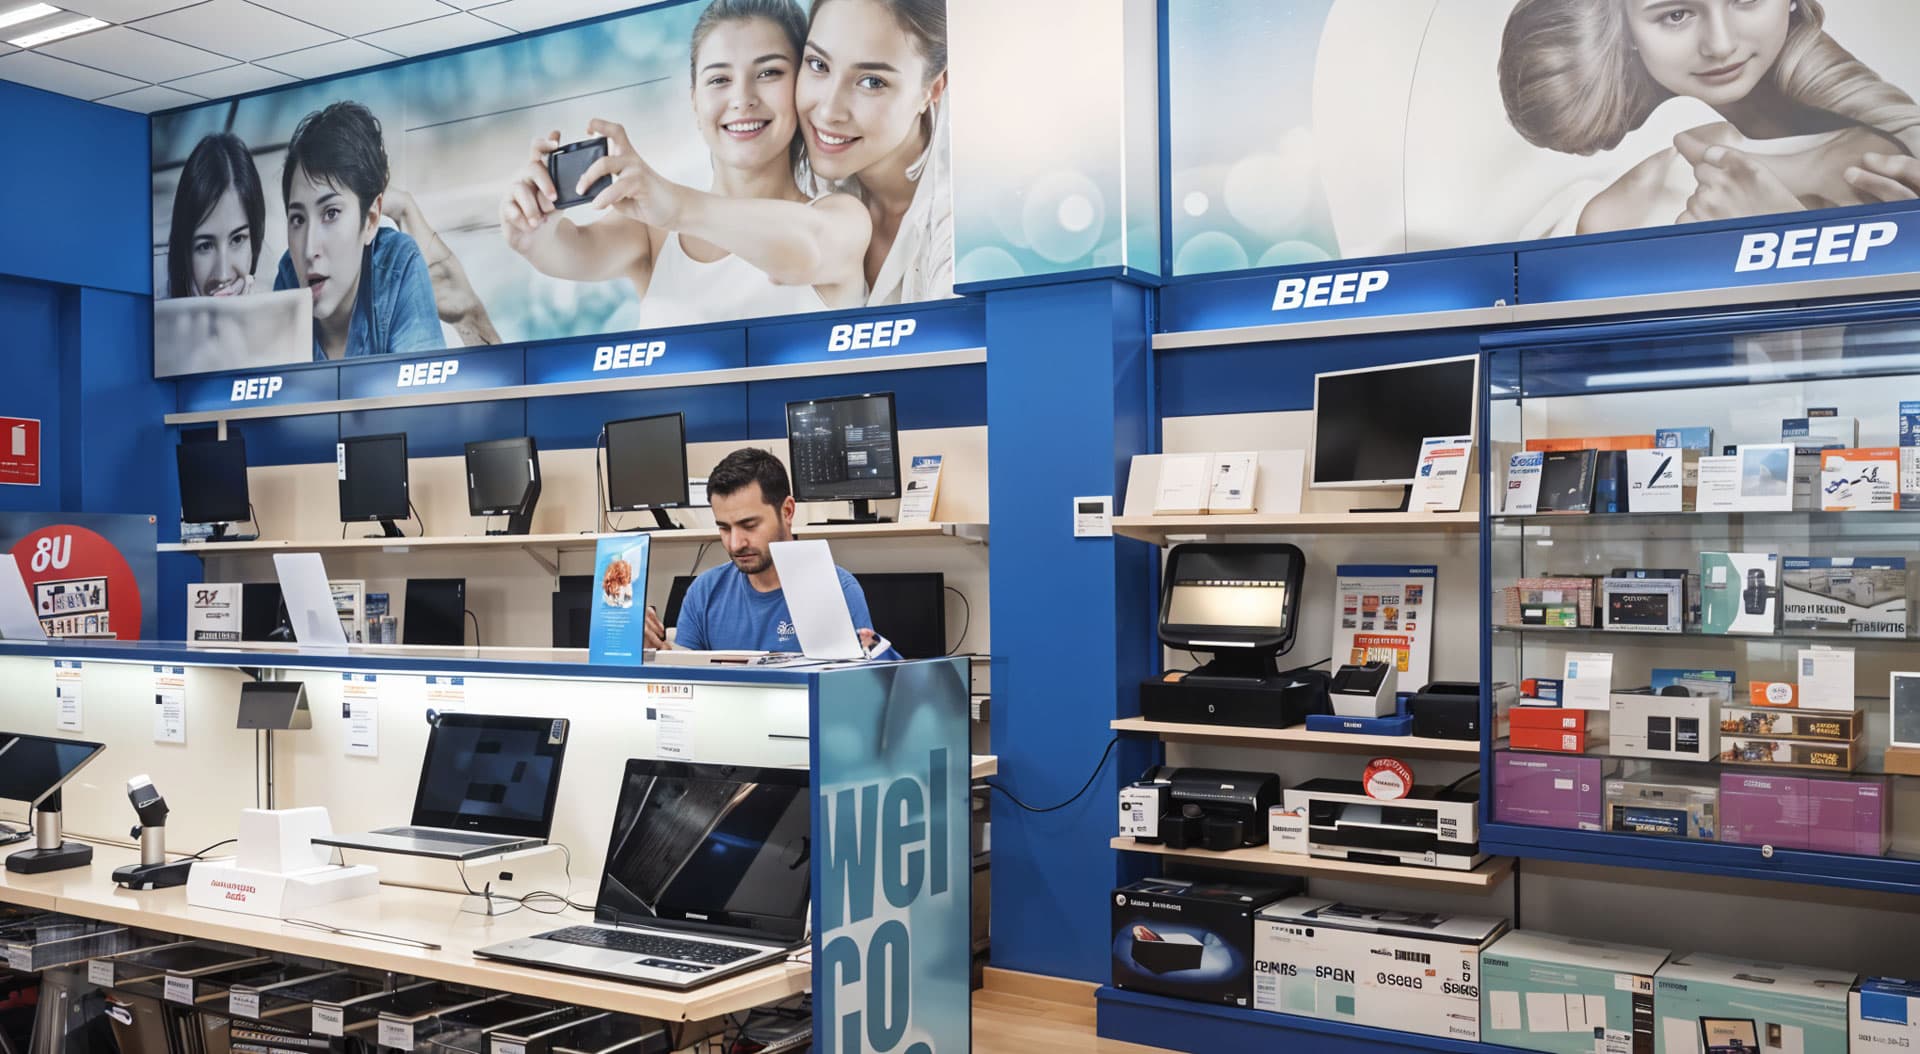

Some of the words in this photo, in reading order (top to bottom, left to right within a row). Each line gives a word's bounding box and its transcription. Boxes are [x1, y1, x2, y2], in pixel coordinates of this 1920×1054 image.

[1735, 221, 1898, 273] BEEP
[1272, 270, 1389, 311] BEEP
[827, 318, 917, 352] BEEP
[396, 360, 459, 388] BEEP
[593, 341, 666, 372] BEEP
[820, 747, 949, 934] wel
